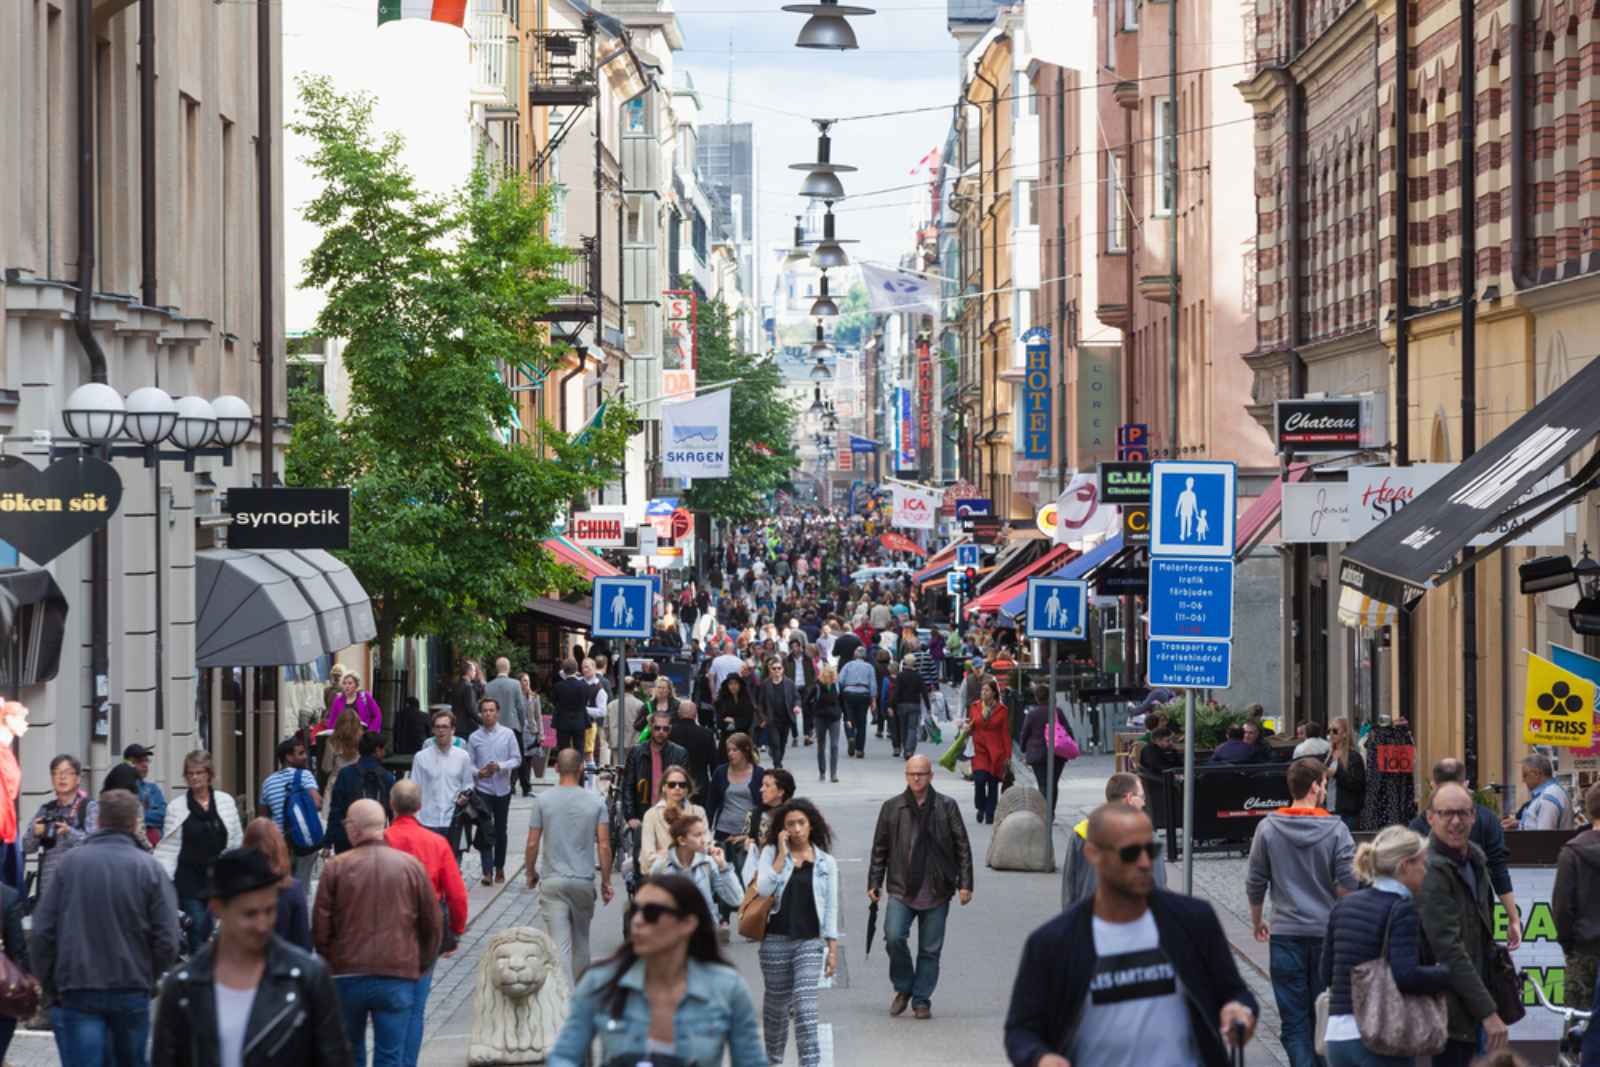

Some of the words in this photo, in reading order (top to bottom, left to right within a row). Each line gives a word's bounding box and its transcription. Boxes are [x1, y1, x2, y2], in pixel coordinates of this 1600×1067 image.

[1028, 351, 1048, 453] HOTEL
[1284, 412, 1357, 431] Chateau
[666, 451, 725, 463] SKAGEN
[0, 492, 62, 512] öken
[69, 493, 108, 512] söt
[903, 499, 927, 511] ICA
[236, 508, 341, 529] synoptik
[577, 519, 622, 540] CHINA
[1178, 576, 1204, 584] trafik
[1169, 587, 1213, 598] förbjuden
[1178, 601, 1203, 610] 11-06
[1175, 612, 1206, 623] (11-06)
[1161, 642, 1204, 652] Transport
[1544, 720, 1587, 735] TRISS
[1243, 797, 1290, 810] Chateau
